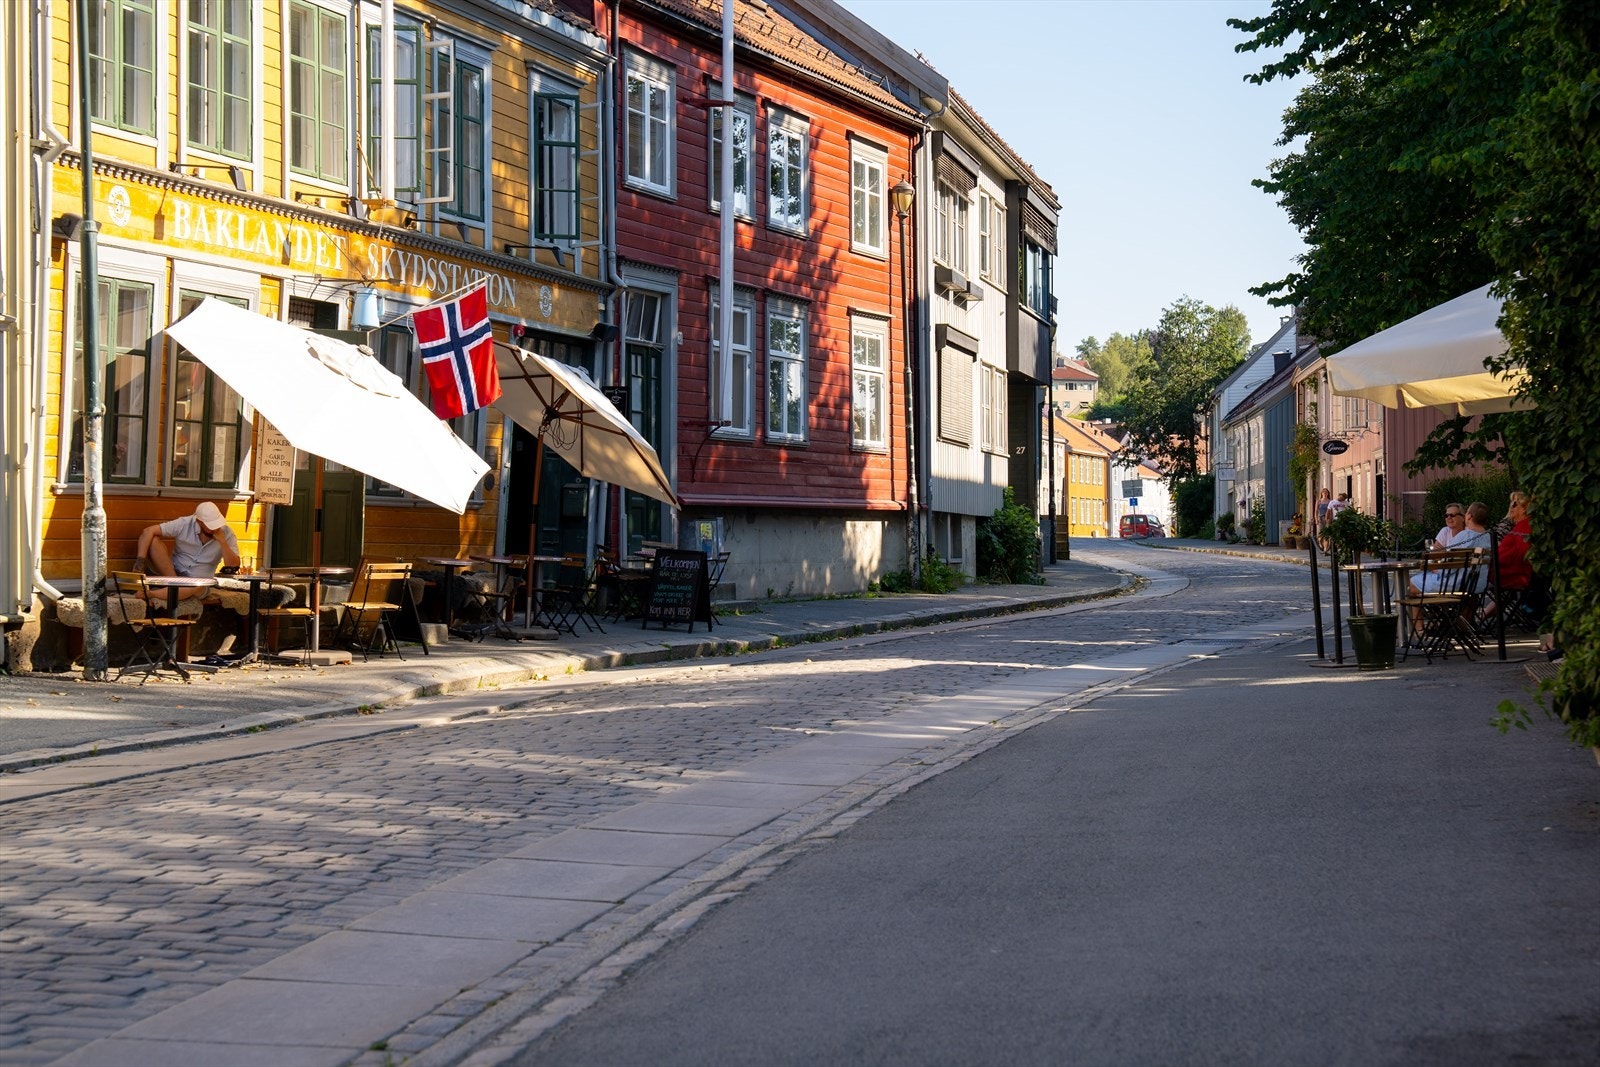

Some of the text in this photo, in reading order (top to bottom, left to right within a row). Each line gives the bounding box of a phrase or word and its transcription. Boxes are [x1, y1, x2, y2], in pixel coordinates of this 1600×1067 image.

[173, 198, 347, 270] BAKLANDET
[367, 243, 516, 308] SKYDSSTATION
[267, 438, 291, 447] KAKER
[1016, 446, 1025, 454] 27
[660, 556, 701, 569] VELKOMMEN
[649, 605, 691, 617] KOM INN HER
